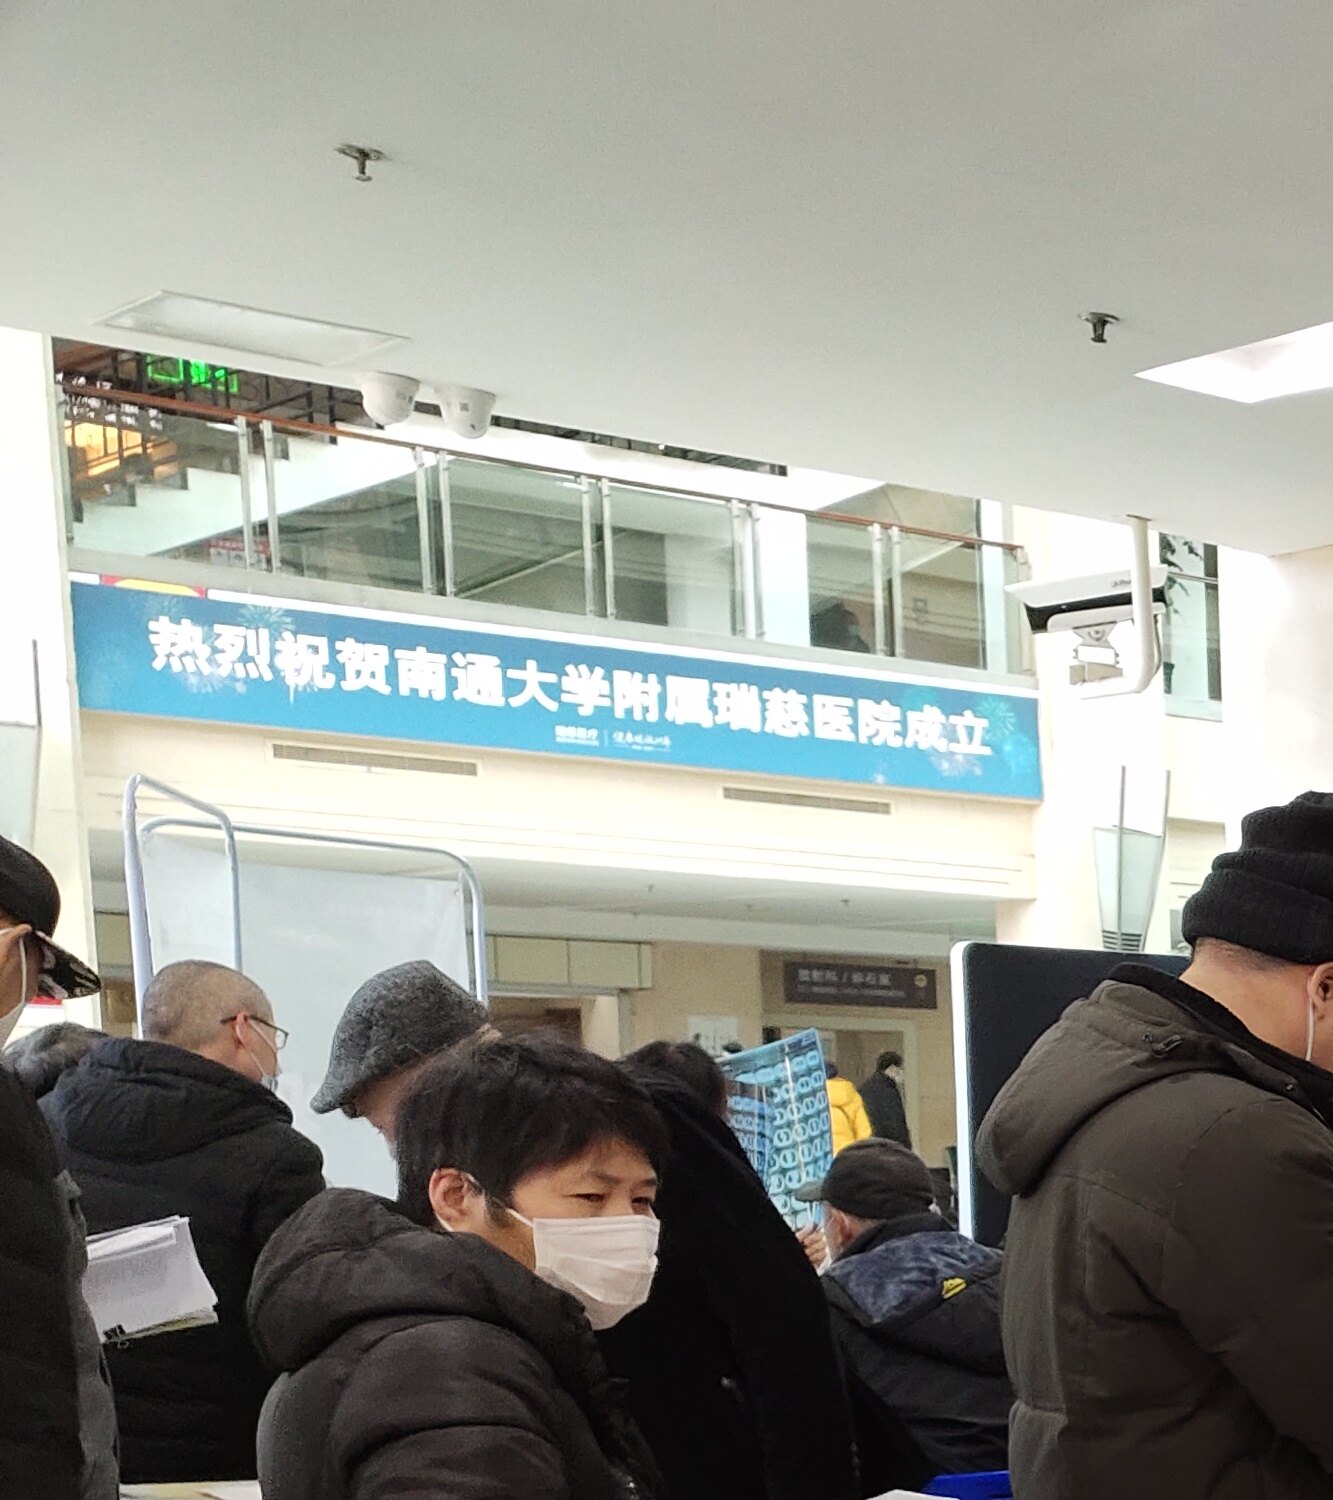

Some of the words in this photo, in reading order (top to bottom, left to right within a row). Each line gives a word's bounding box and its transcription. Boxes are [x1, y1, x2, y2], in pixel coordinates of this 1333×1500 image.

[148, 615, 992, 757] 热烈祝贺南通大学附属瑞慈医院成立
